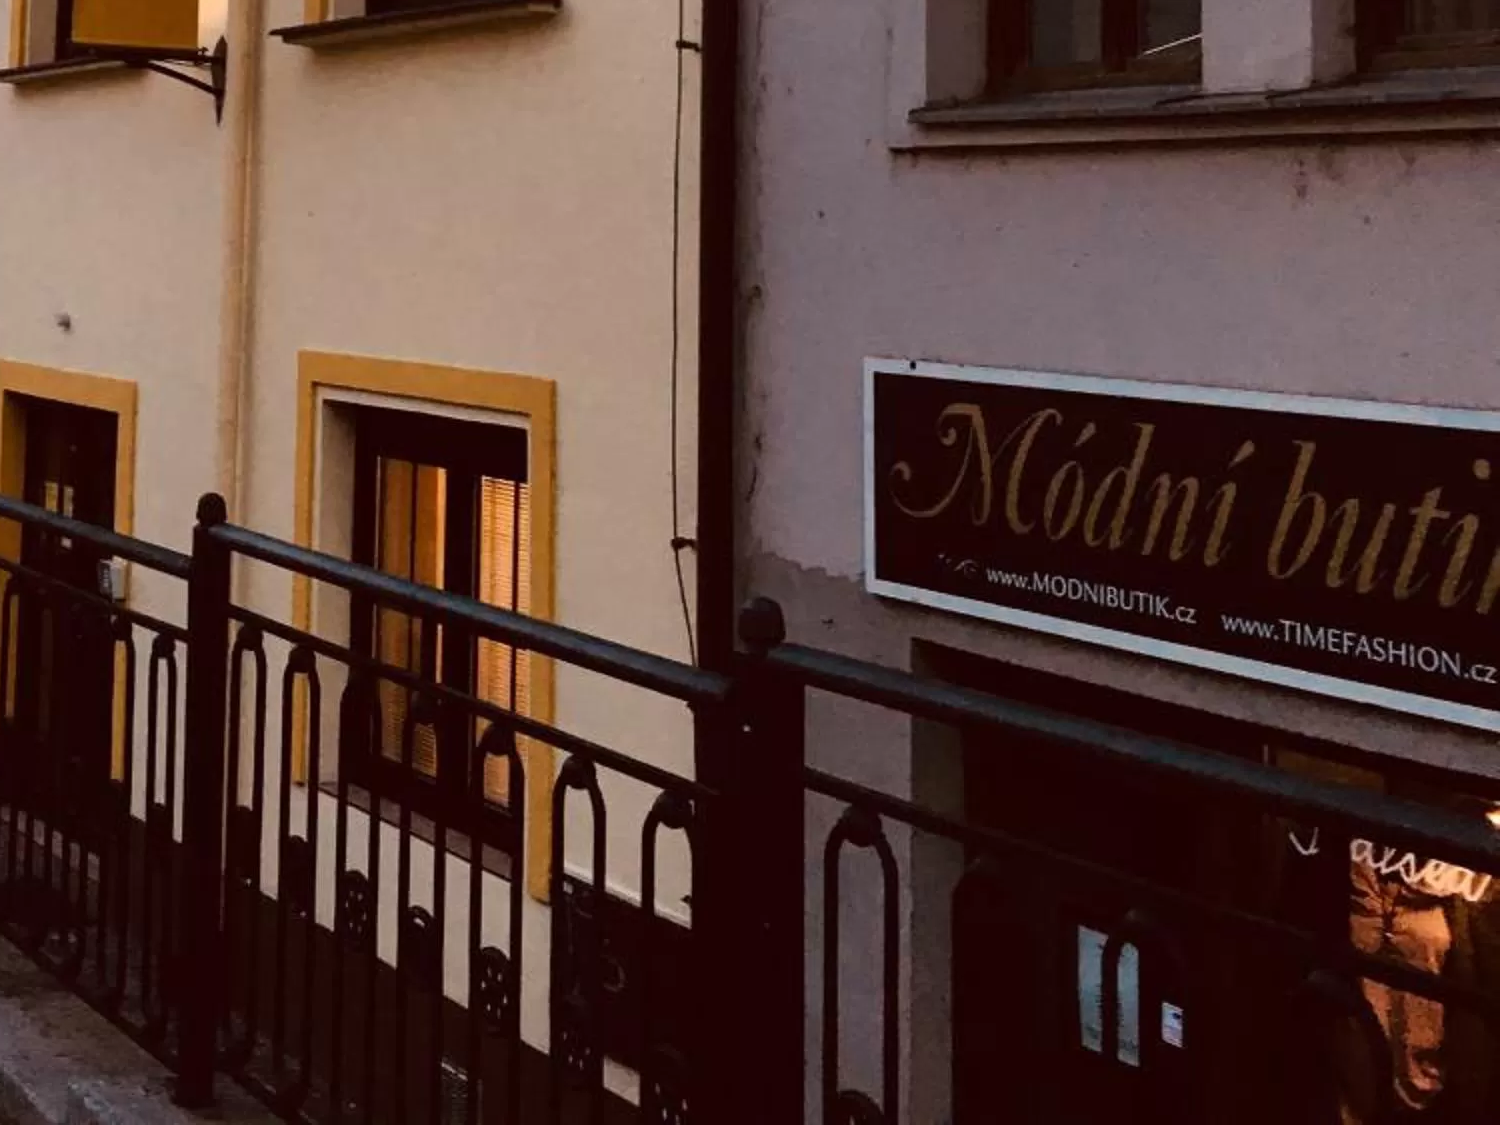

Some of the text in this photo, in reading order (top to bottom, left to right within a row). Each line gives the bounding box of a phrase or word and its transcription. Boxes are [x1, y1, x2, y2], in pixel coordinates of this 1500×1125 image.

[889, 402, 1500, 616] Módní buti
[986, 567, 1498, 685] www.MODNIBUTIK.cz www.TIMEFASHION.cz
